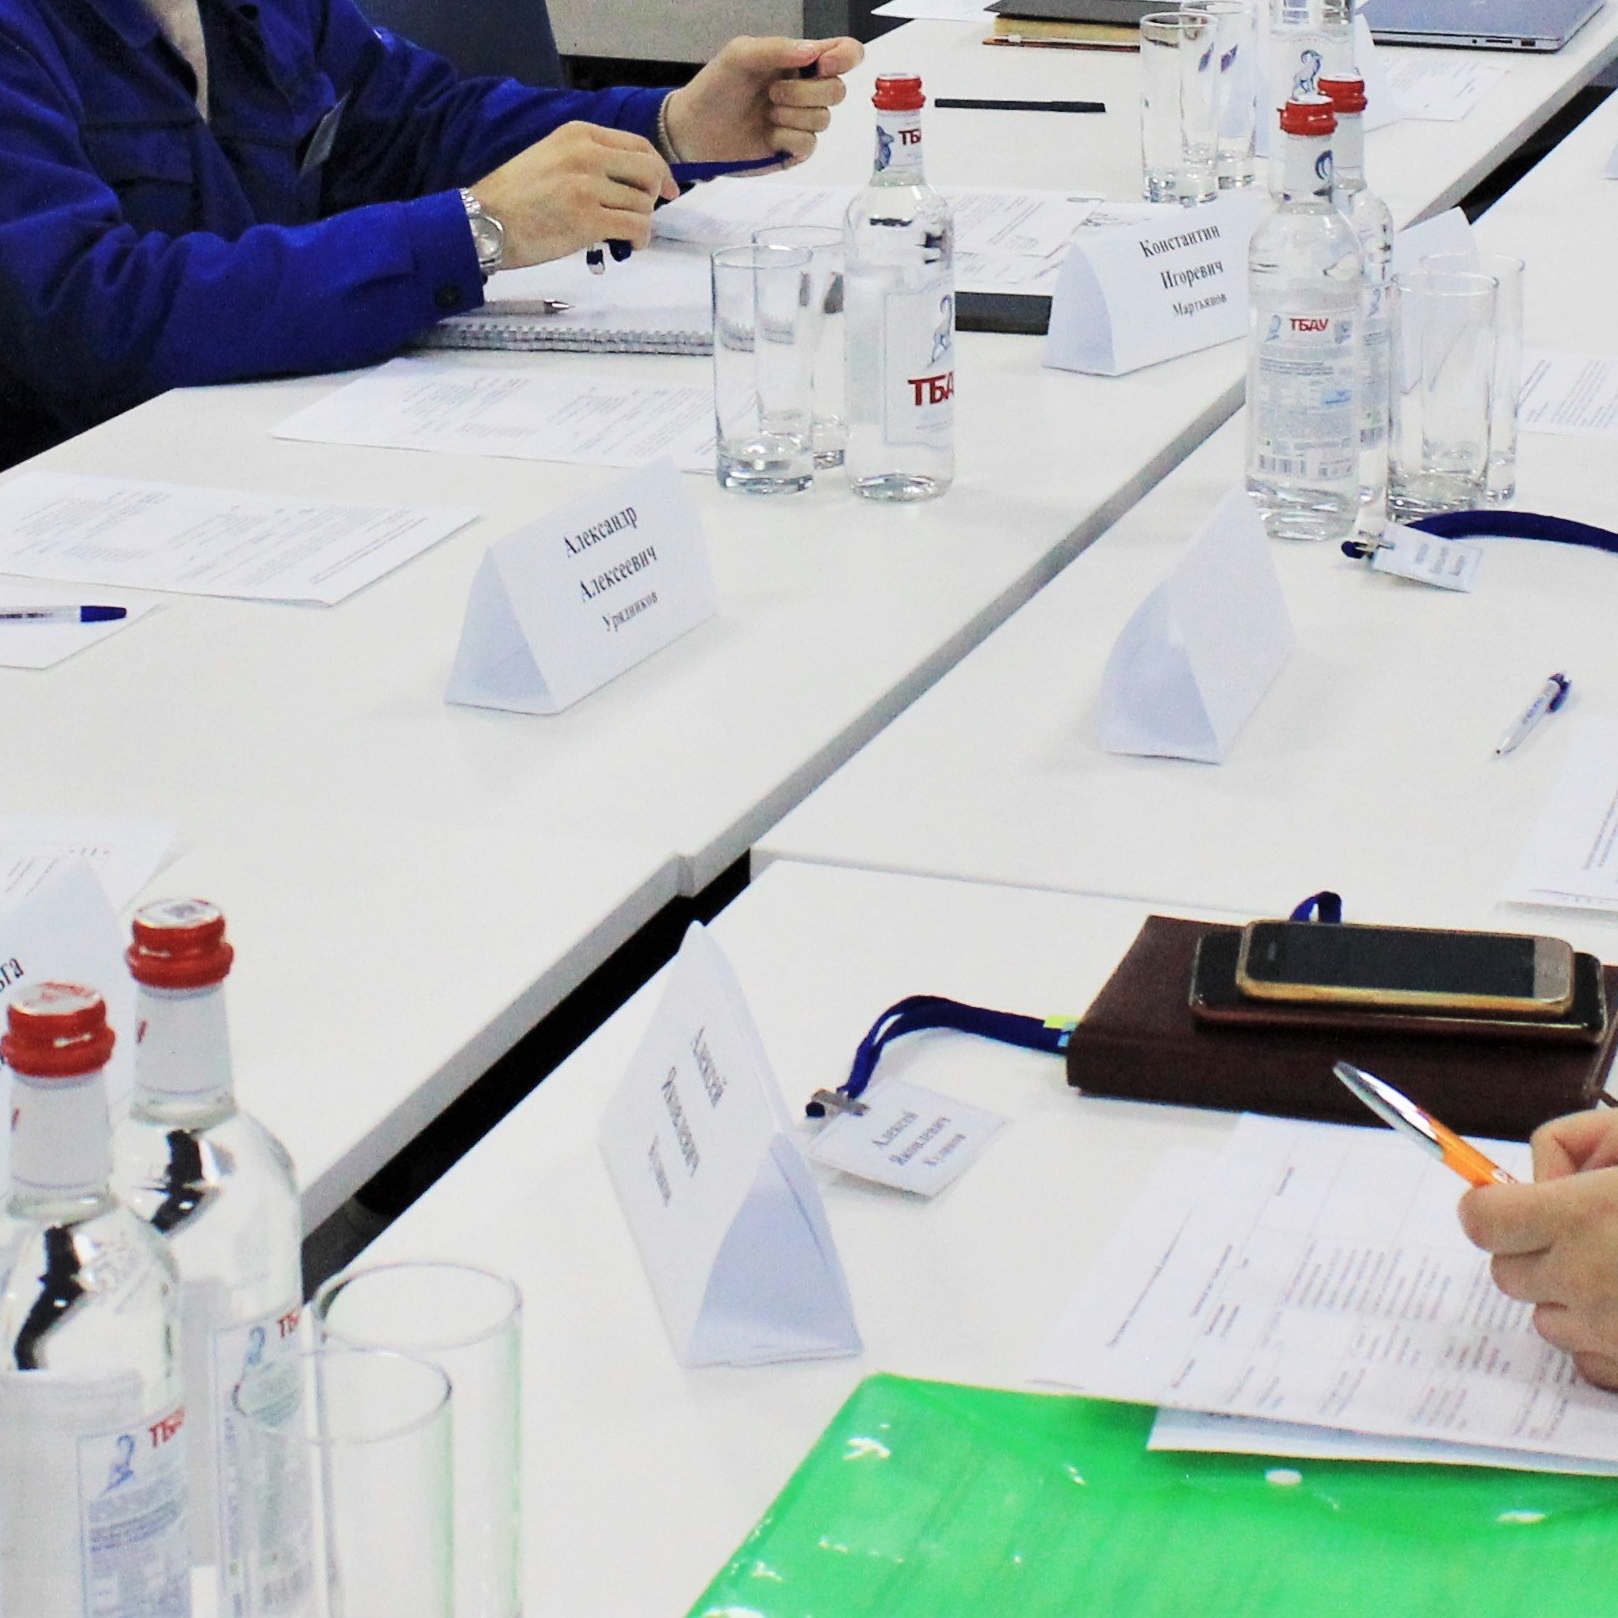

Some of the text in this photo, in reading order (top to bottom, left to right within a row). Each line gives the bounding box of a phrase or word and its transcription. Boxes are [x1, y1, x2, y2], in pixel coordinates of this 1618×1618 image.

[898, 128, 922, 146] ТБ
[1139, 225, 1221, 257] Константин
[1160, 261, 1224, 289] Игоревич
[1289, 318, 1330, 332] ТБАУ
[907, 370, 955, 406] ТБА
[563, 506, 638, 558] Александр
[579, 545, 659, 603] Алексеевич
